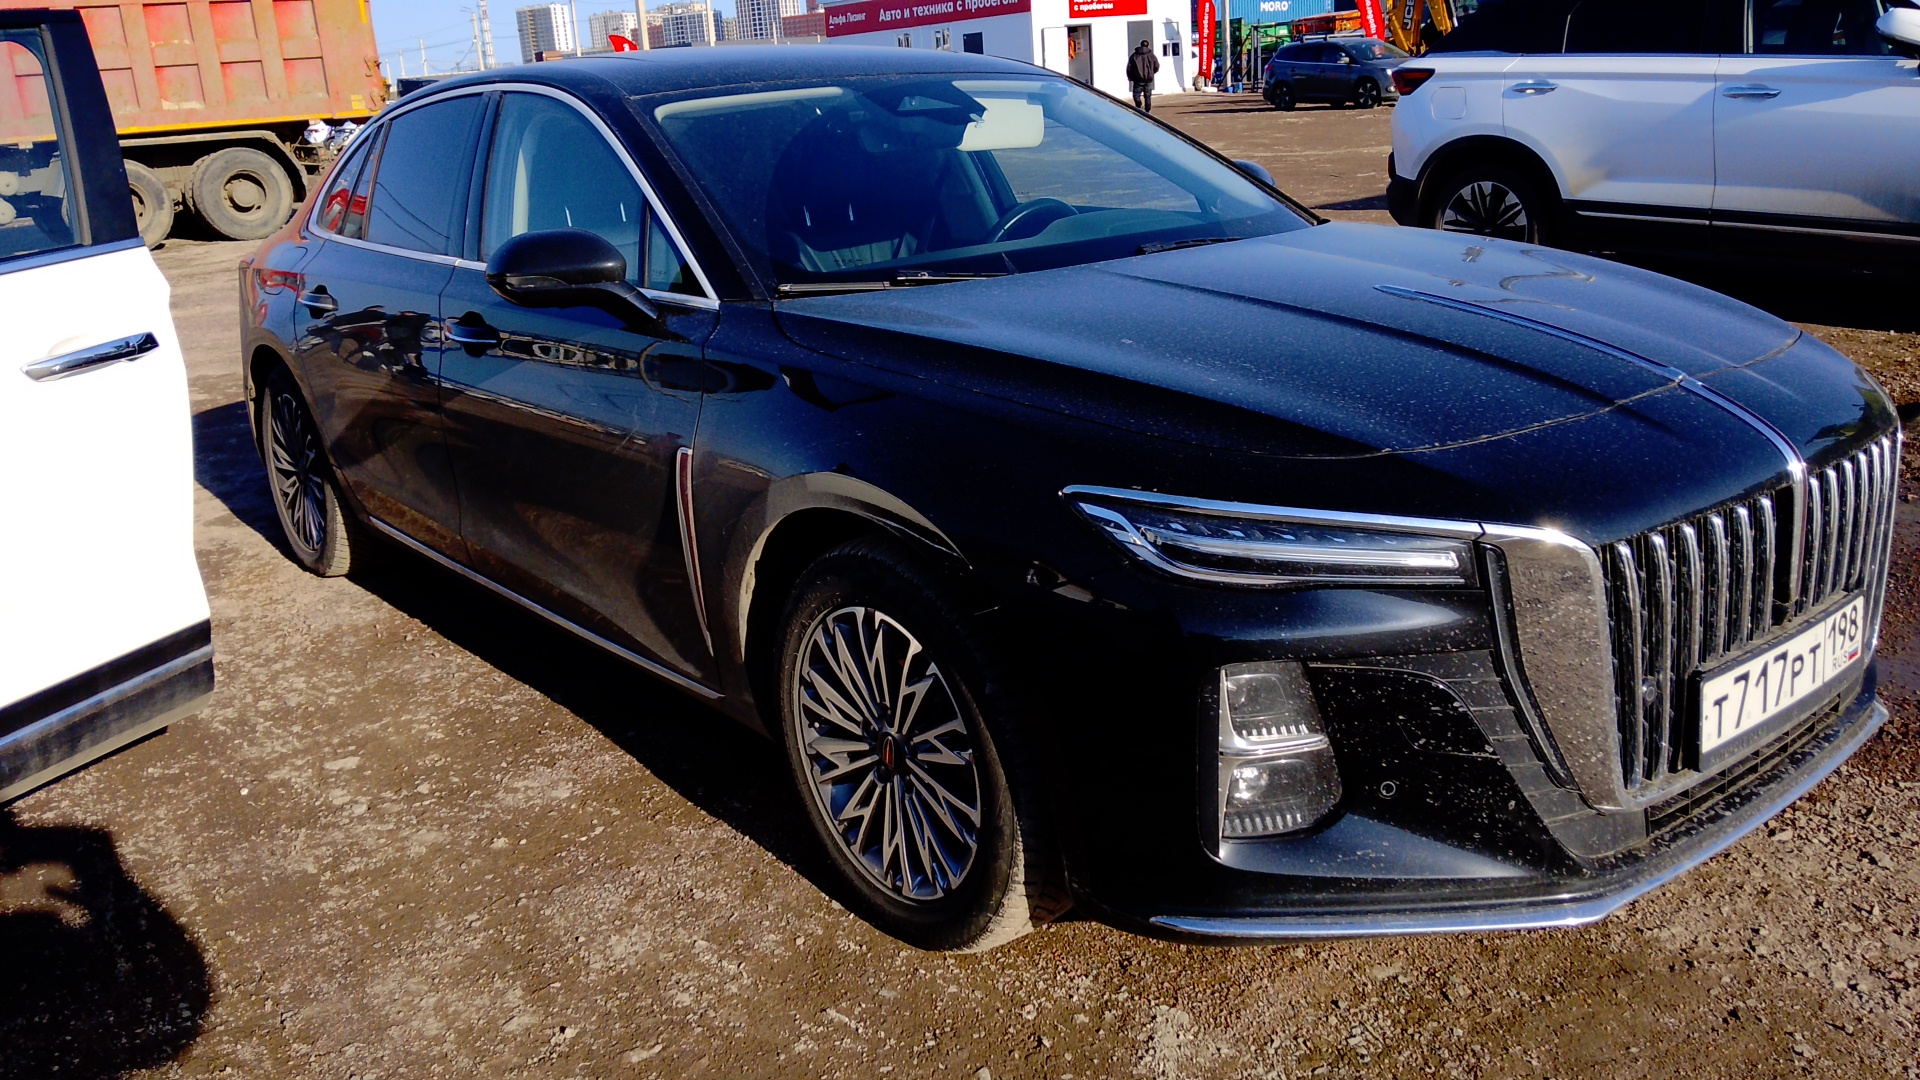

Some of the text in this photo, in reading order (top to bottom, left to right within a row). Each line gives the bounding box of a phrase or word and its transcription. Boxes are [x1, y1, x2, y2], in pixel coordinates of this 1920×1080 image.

[879, 8, 901, 22] Авто
[903, 7, 910, 18] и
[912, 2, 953, 17] техника
[956, 0, 963, 11] с
[1080, 2, 1114, 12] пробегом
[1260, 1, 1288, 12] MORO
[1365, 0, 1377, 34] пробего
[1828, 604, 1859, 655] 198
[1832, 650, 1848, 670] RUS
